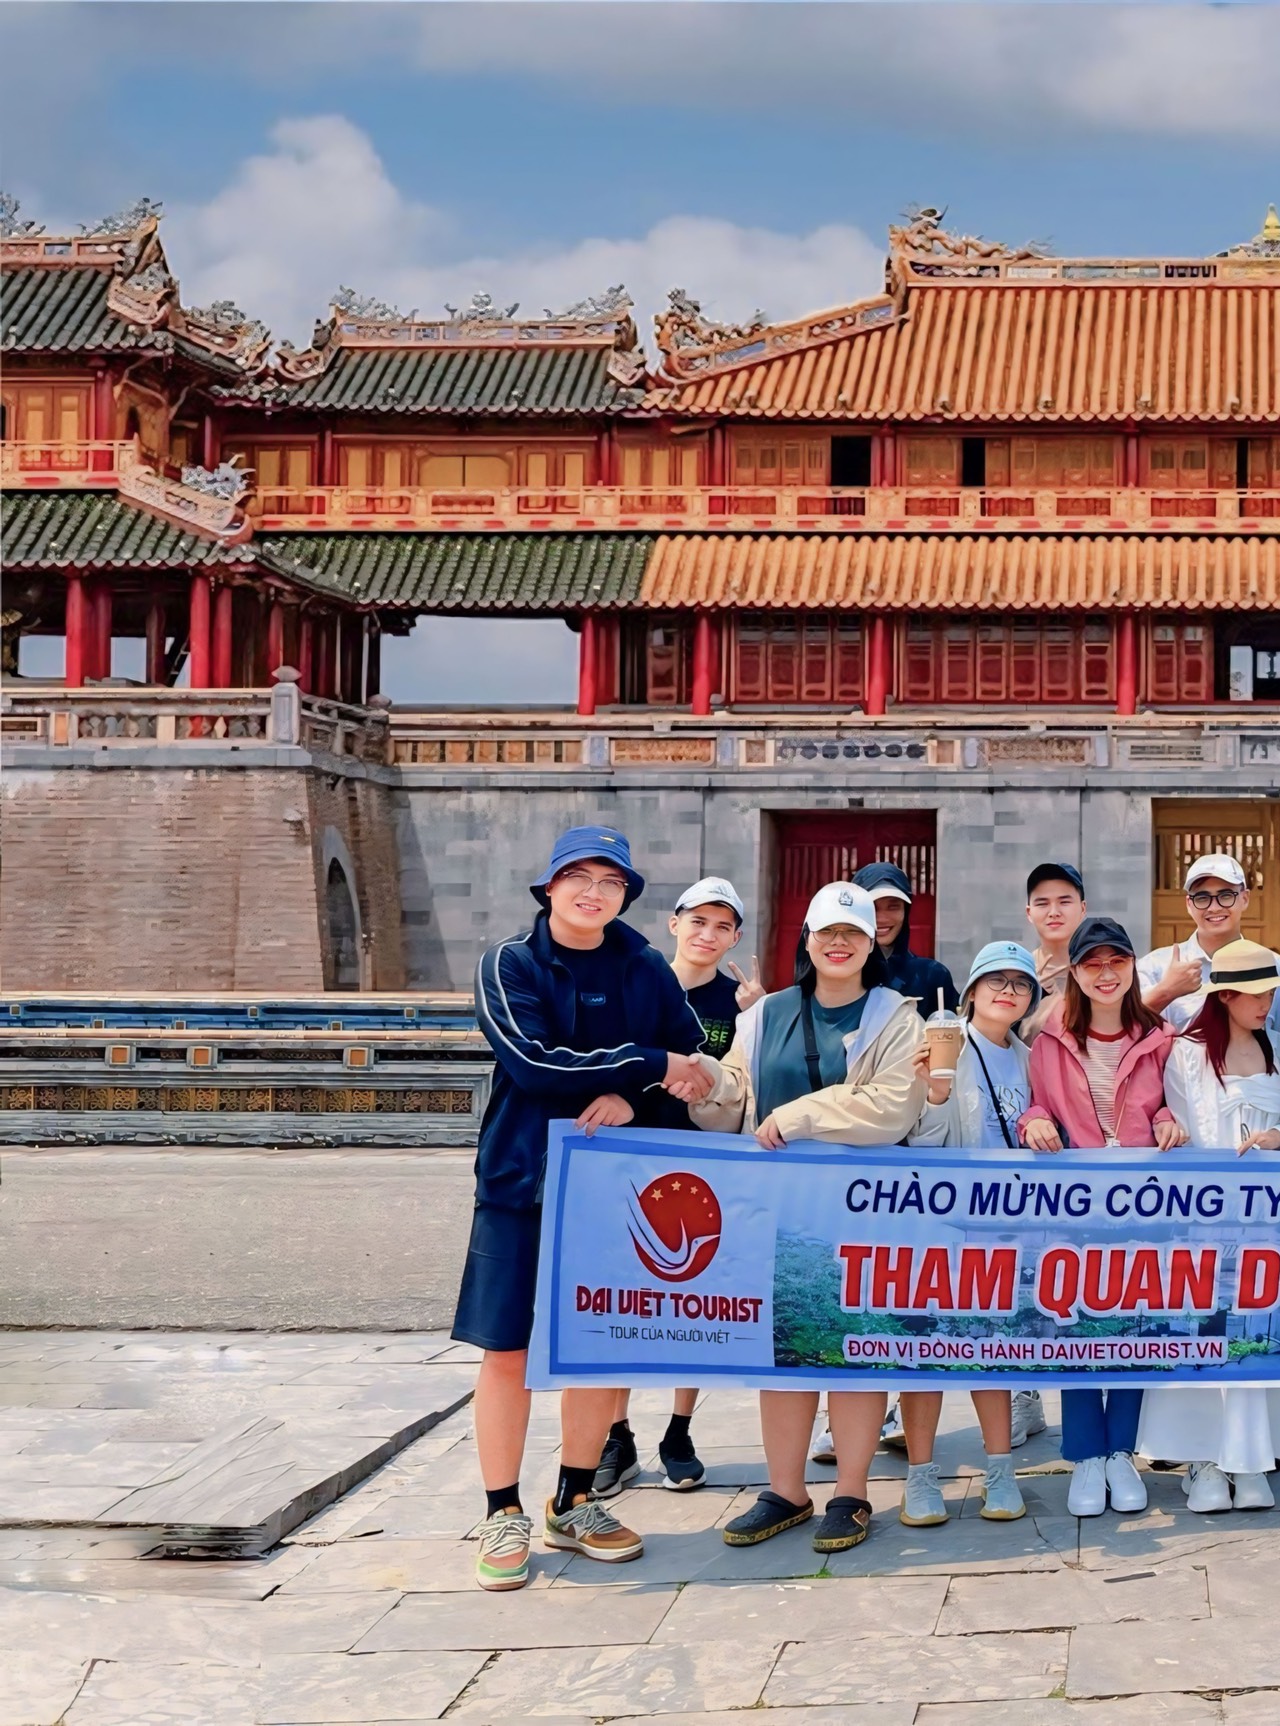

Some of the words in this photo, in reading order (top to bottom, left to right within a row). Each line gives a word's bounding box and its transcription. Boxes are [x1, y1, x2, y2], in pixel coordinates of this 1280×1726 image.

[845, 1171, 957, 1215] CHÀO
[969, 1173, 1092, 1217] MỪNG
[1105, 1175, 1224, 1217] CÔNG
[839, 1244, 1017, 1310] THAM
[1038, 1248, 1217, 1319] QUAN
[576, 1285, 612, 1316] ĐẠI
[618, 1287, 665, 1319] VIỆT
[669, 1293, 763, 1323] TOURIST
[609, 1326, 639, 1343] TOUR
[641, 1325, 664, 1341] CỦA
[666, 1328, 704, 1343] NGƯỜI
[847, 1340, 890, 1357] ĐƠN
[895, 1341, 914, 1362] VỊ
[981, 1339, 1035, 1360] HÀNH
[1042, 1342, 1224, 1361] DAIVIETOURIST.VN
